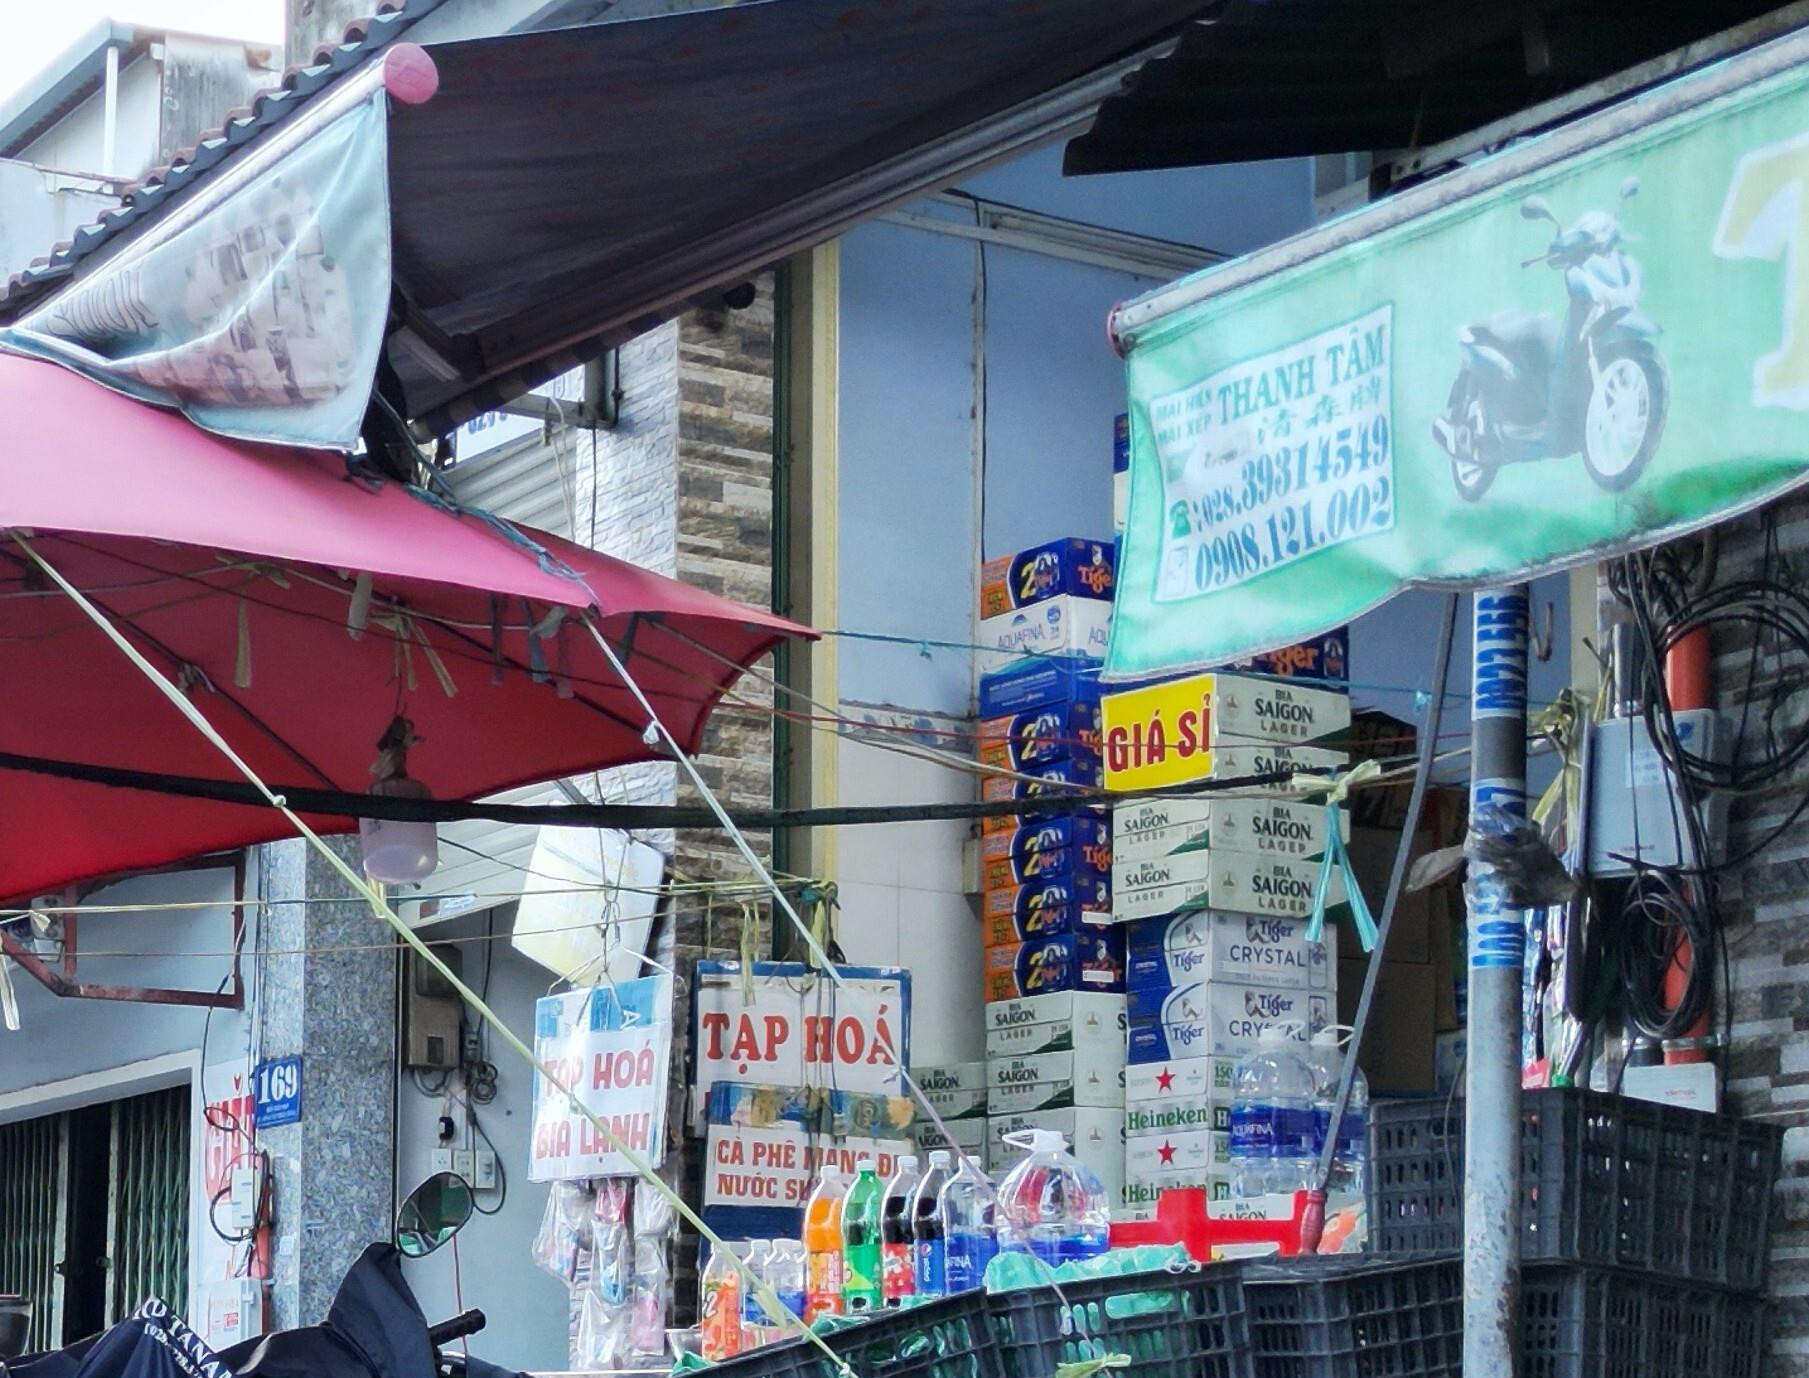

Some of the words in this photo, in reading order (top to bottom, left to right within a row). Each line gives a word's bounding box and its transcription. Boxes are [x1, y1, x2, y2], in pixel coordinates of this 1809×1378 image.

[1218, 356, 1316, 425] THANH
[1327, 325, 1385, 386] TÂM
[1195, 476, 1390, 591] 0908.121.002
[1078, 566, 1113, 593] Tige
[998, 624, 1045, 649] AQUAFINA
[1275, 689, 1292, 701] BIA
[1255, 698, 1313, 724] SAIGON
[1107, 709, 1165, 773] GIÁ
[1178, 693, 1211, 758] SỈ
[1261, 719, 1308, 737] LAGER
[1274, 746, 1292, 759] BIA
[1254, 756, 1313, 774] SAIGON
[1124, 813, 1169, 832] SAIGON
[1273, 807, 1291, 819] BIA
[1129, 831, 1165, 845] LAGER
[1252, 817, 1312, 840] SAIGON
[1258, 839, 1306, 853] LAGER
[1125, 869, 1170, 887] SAIGON
[1273, 866, 1292, 877] BIA
[1252, 875, 1312, 898] SAIGON
[1128, 891, 1164, 904] LAGER
[1258, 897, 1306, 912] LAGER
[1261, 920, 1294, 942] Tiger
[1174, 952, 1205, 972] Tiger
[1230, 945, 1306, 967] CRYSTAL
[1259, 994, 1294, 1017] Tiger
[995, 1009, 1036, 1026] SAIGON
[703, 1013, 789, 1074] TẠP
[804, 1004, 895, 1065] HOÁ
[1000, 1029, 1032, 1041] LAGER
[1173, 1025, 1204, 1045] Tiger
[593, 1041, 655, 1090] HOÁ
[998, 1067, 1038, 1083] SAIGON
[258, 1064, 298, 1104] 169
[920, 1076, 960, 1090] SAIGON
[1001, 1086, 1034, 1096] LAGER
[1128, 1106, 1207, 1131] Heineken
[535, 1119, 571, 1160] BIA
[580, 1113, 650, 1163] LẠNH
[717, 1136, 744, 1165] CÀ
[752, 1139, 796, 1169] PHÊ
[717, 1172, 778, 1198] NƯỚC
